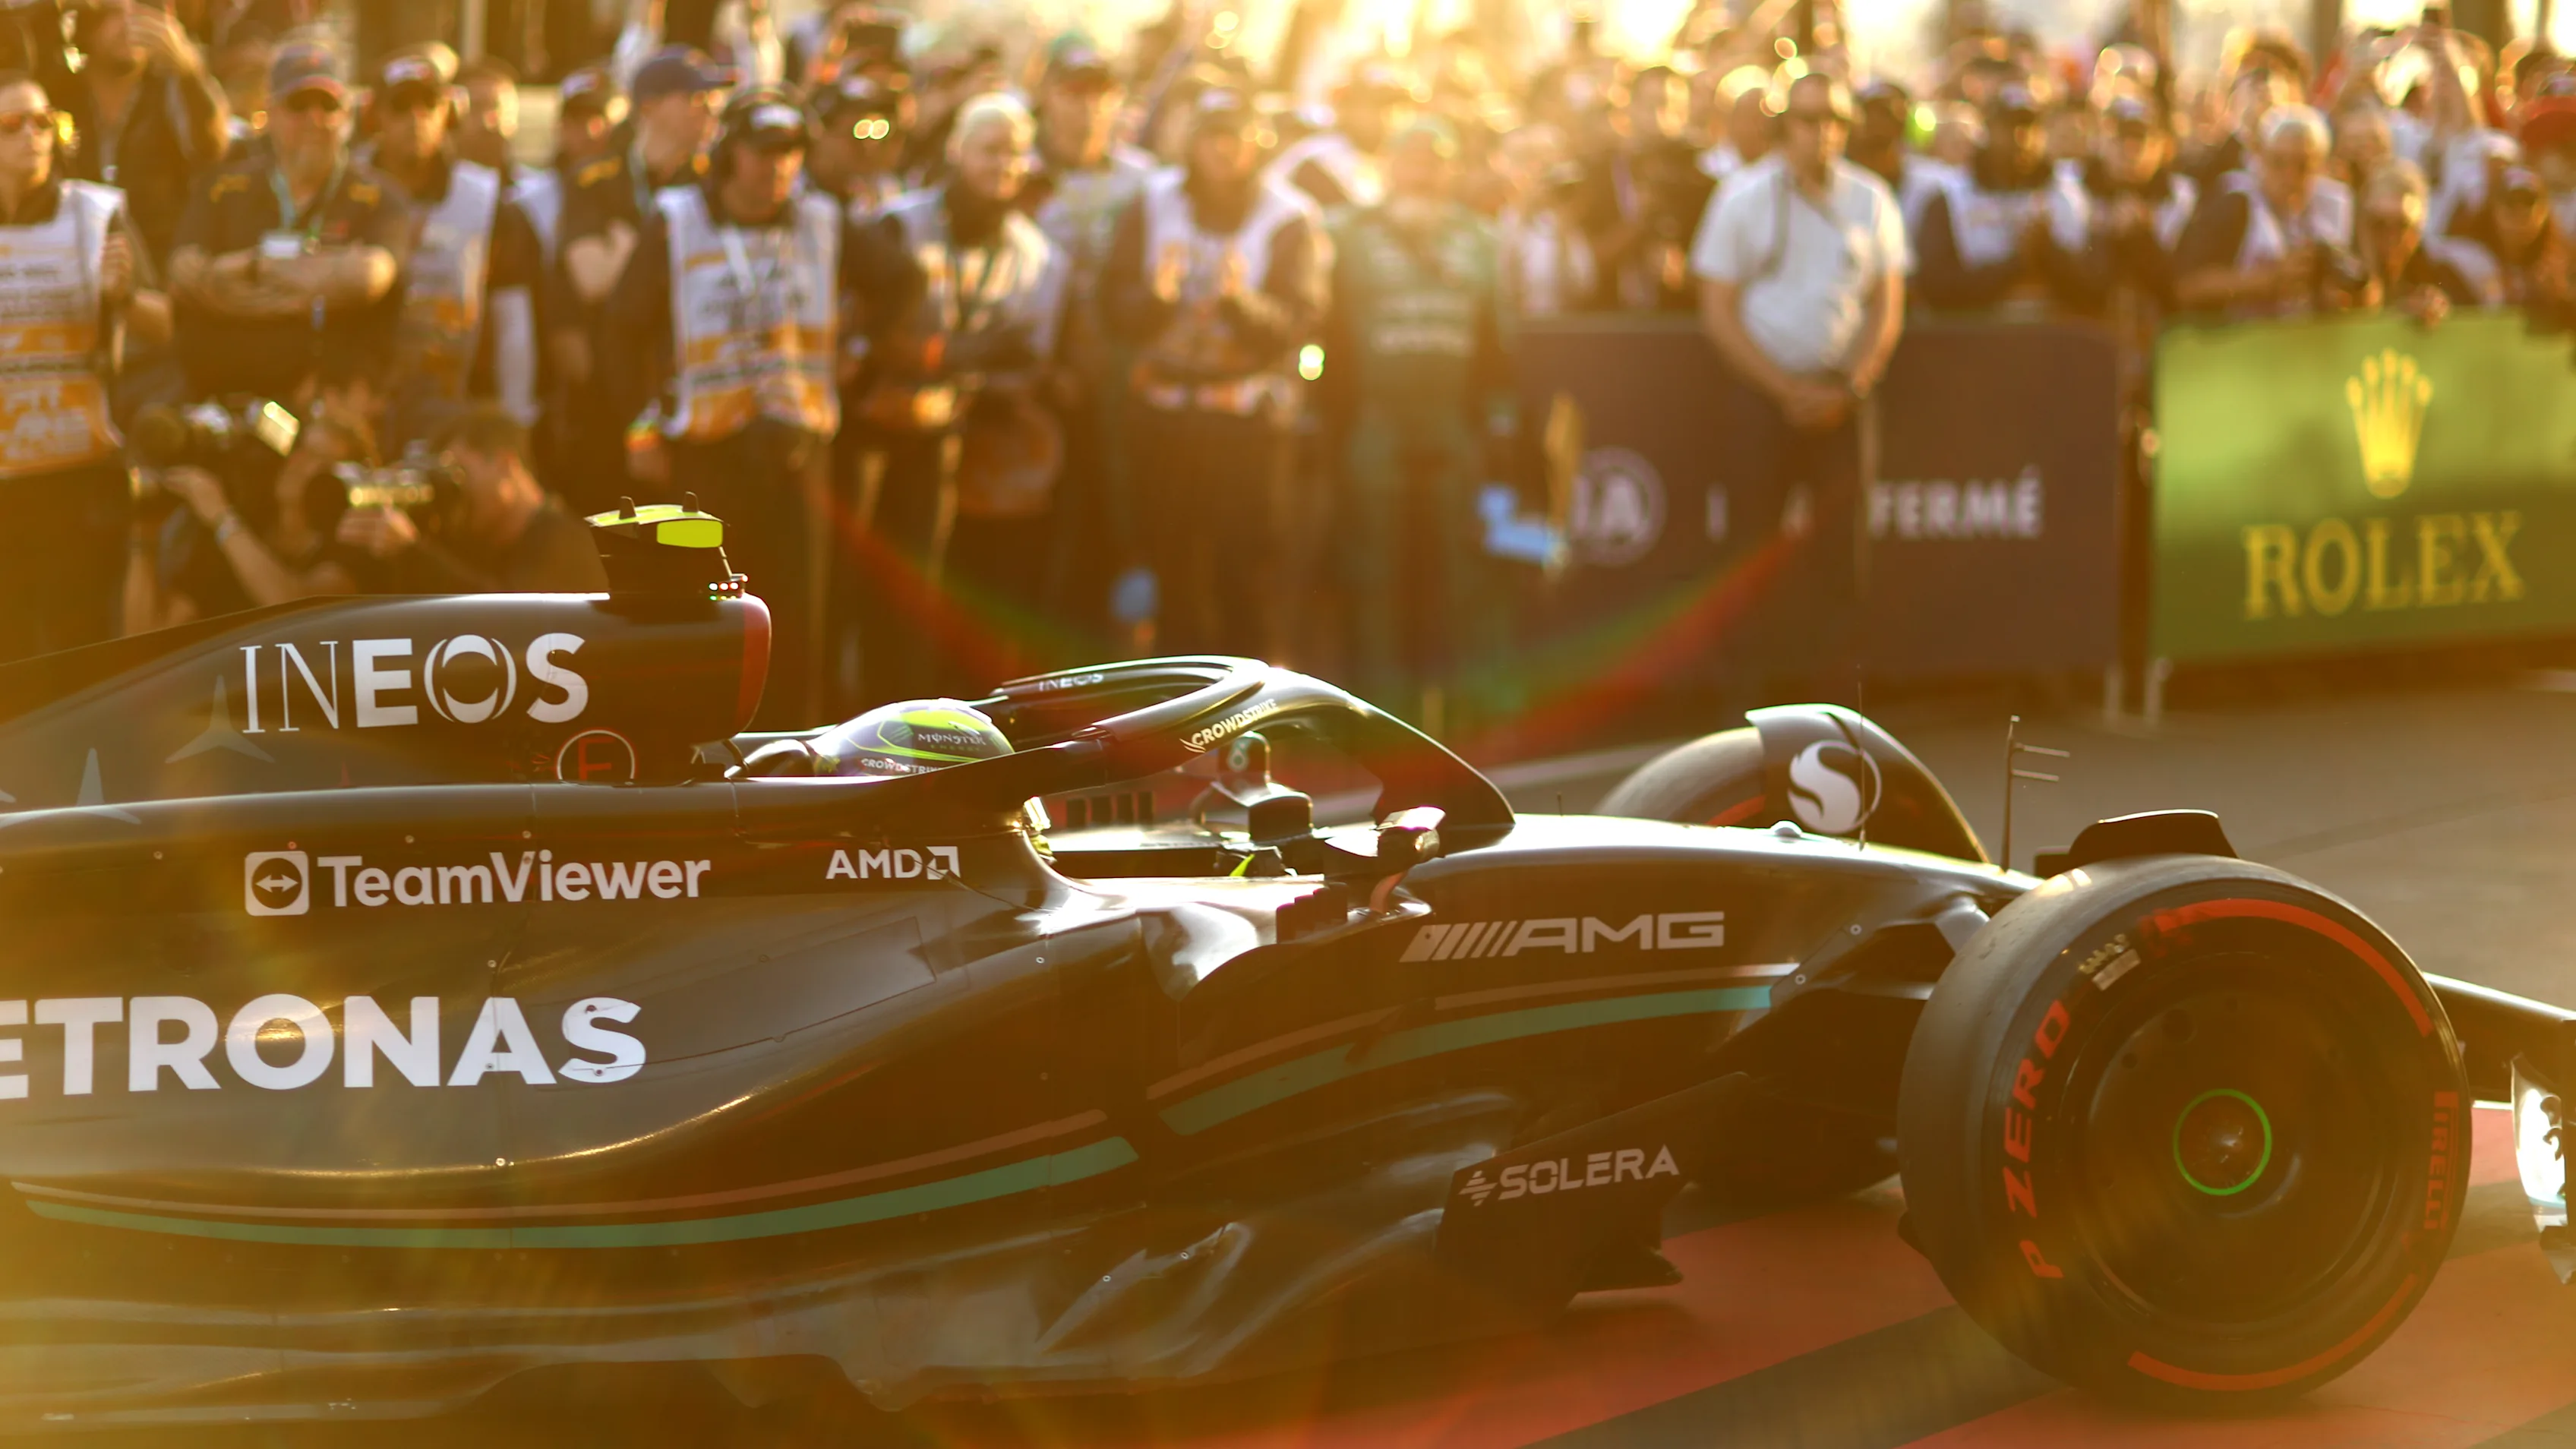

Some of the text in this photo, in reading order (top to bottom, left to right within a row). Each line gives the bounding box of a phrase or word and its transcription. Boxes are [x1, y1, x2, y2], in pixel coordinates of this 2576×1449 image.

[1870, 463, 2043, 537] FERMÉ
[2243, 510, 2525, 620] ROLEX
[240, 633, 589, 734] INEOS
[1039, 674, 1103, 691] INEOS
[1192, 699, 1278, 747] CROWDSTRIKE
[317, 850, 711, 908] TeamViewer
[826, 848, 923, 879] AMD
[1501, 911, 1724, 957] AMG
[2003, 999, 2071, 1279] P ZERO
[1498, 1144, 1680, 1201] SOLERA
